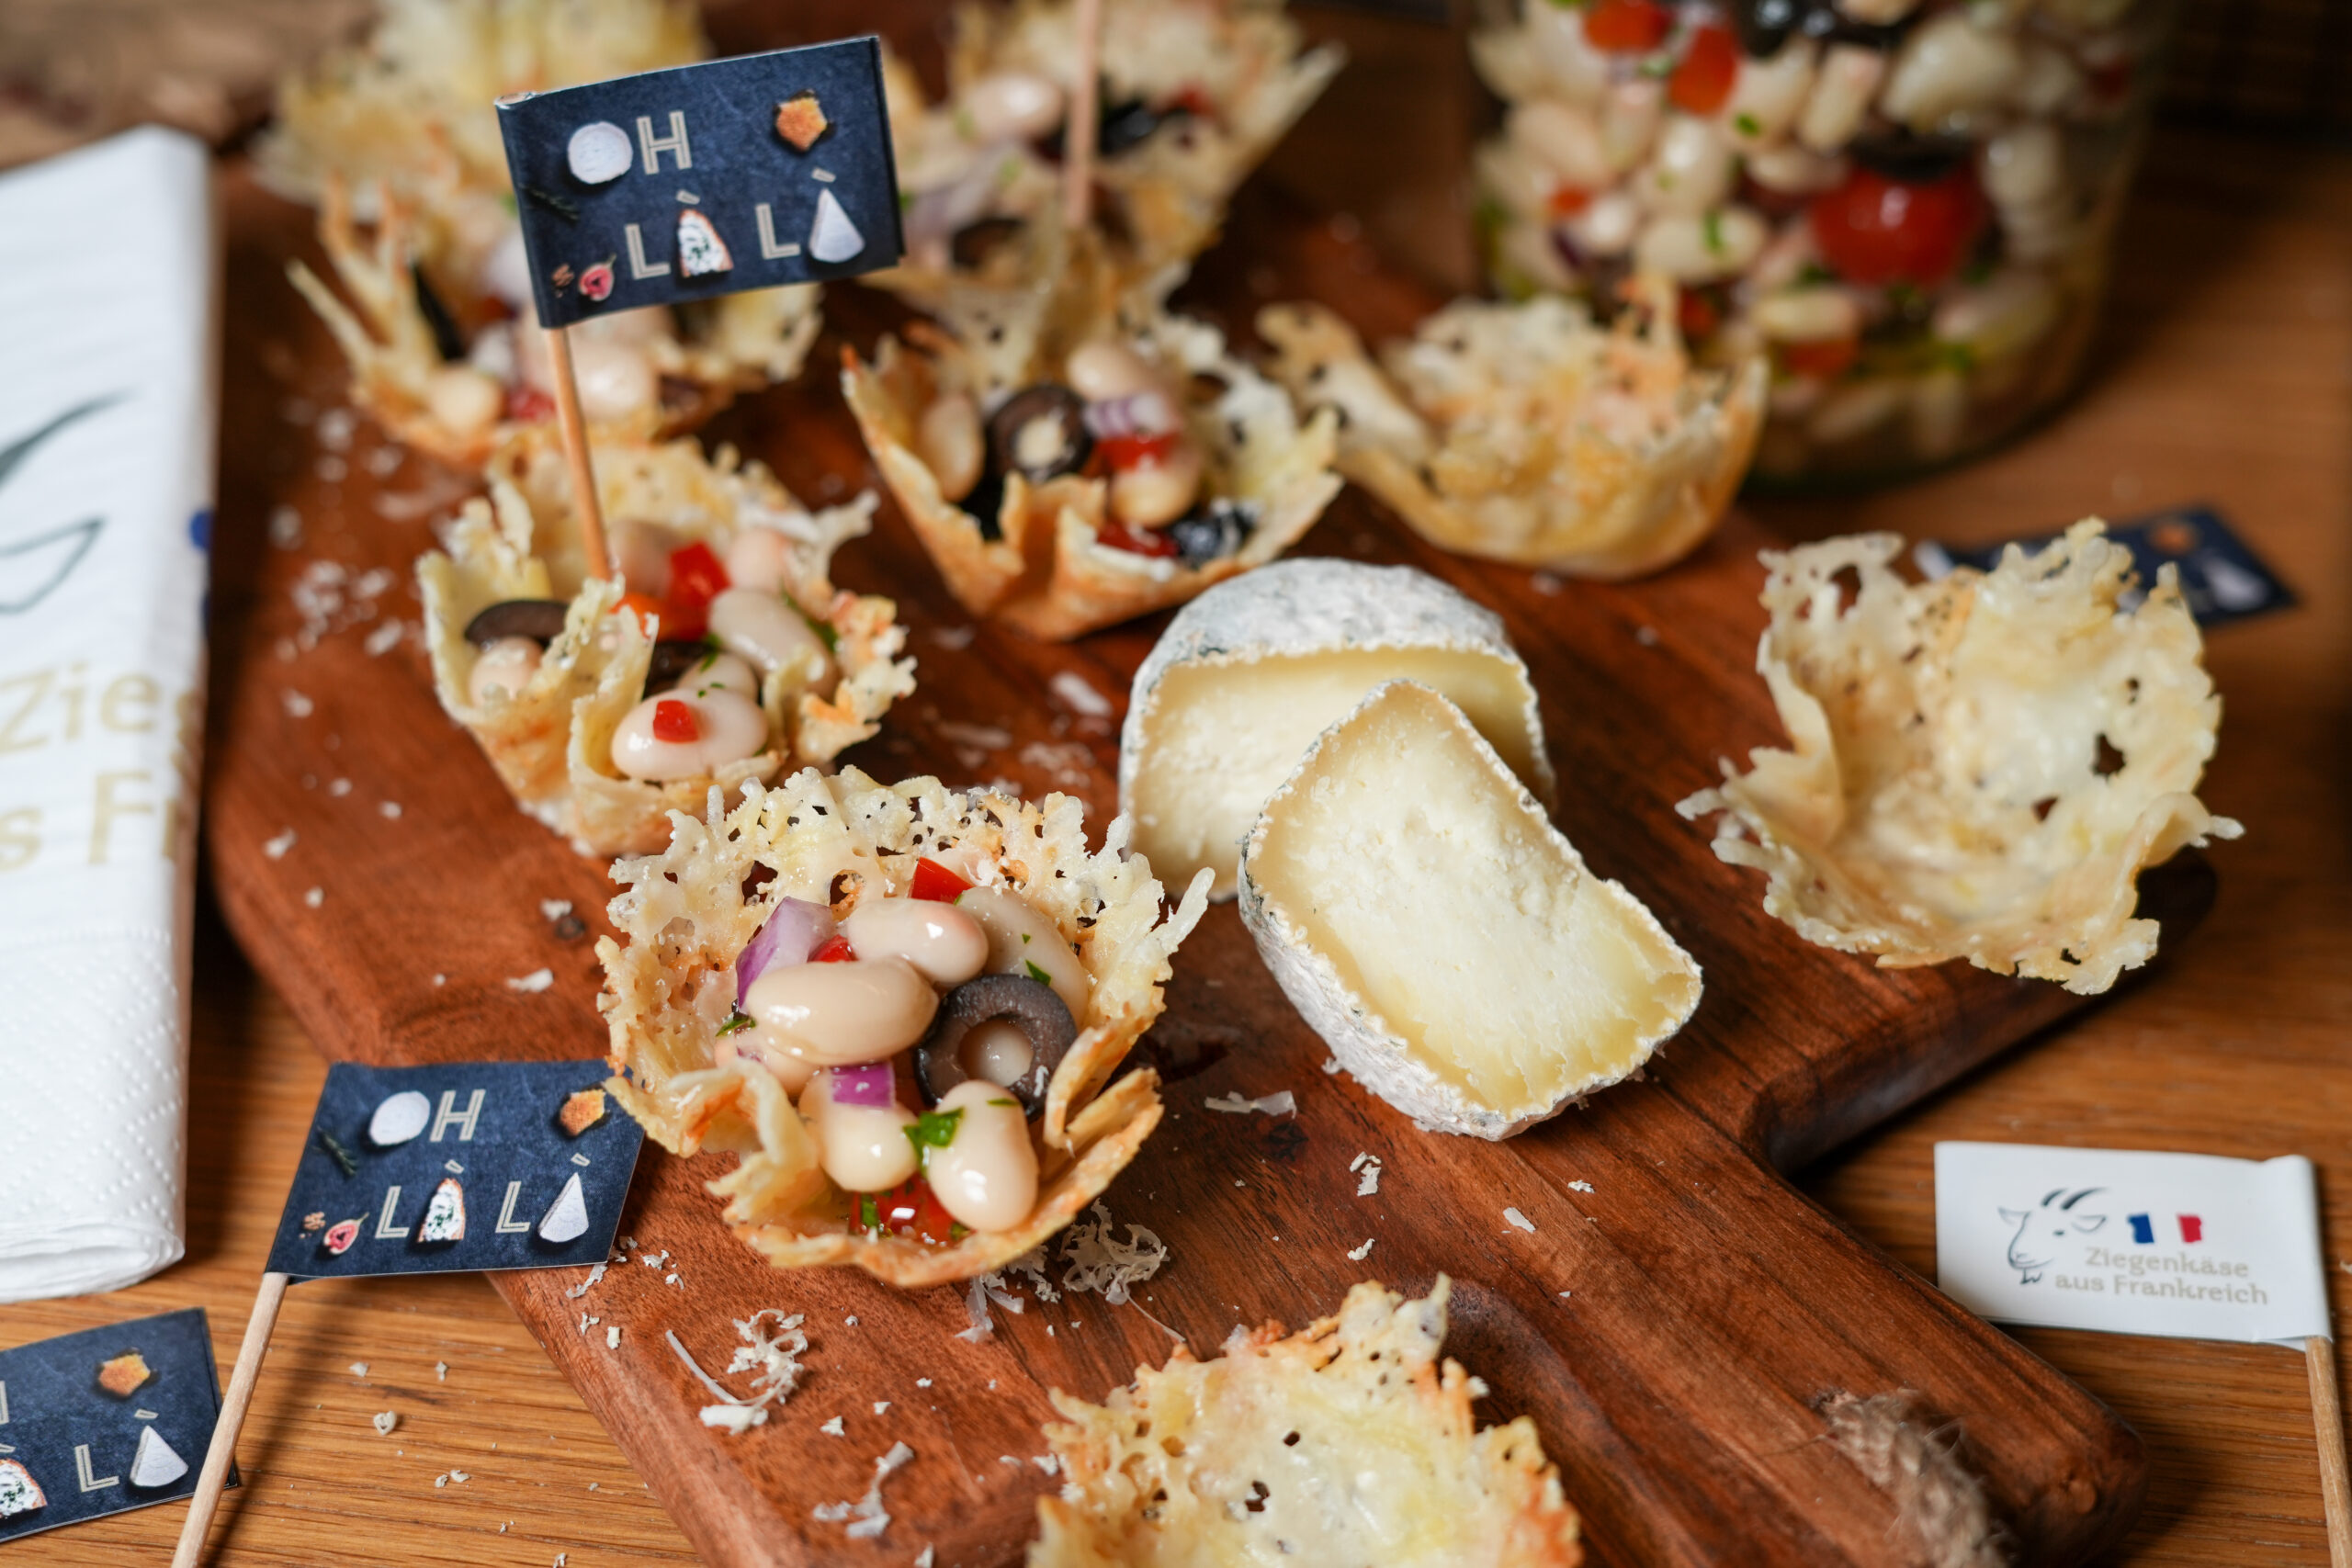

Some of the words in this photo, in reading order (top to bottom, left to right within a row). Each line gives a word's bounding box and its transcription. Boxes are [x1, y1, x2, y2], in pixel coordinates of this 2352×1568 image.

[2085, 1247, 2249, 1277] Ziegenkäse
[2054, 1273, 2105, 1292] aus
[2113, 1276, 2268, 1305] Frankreich
